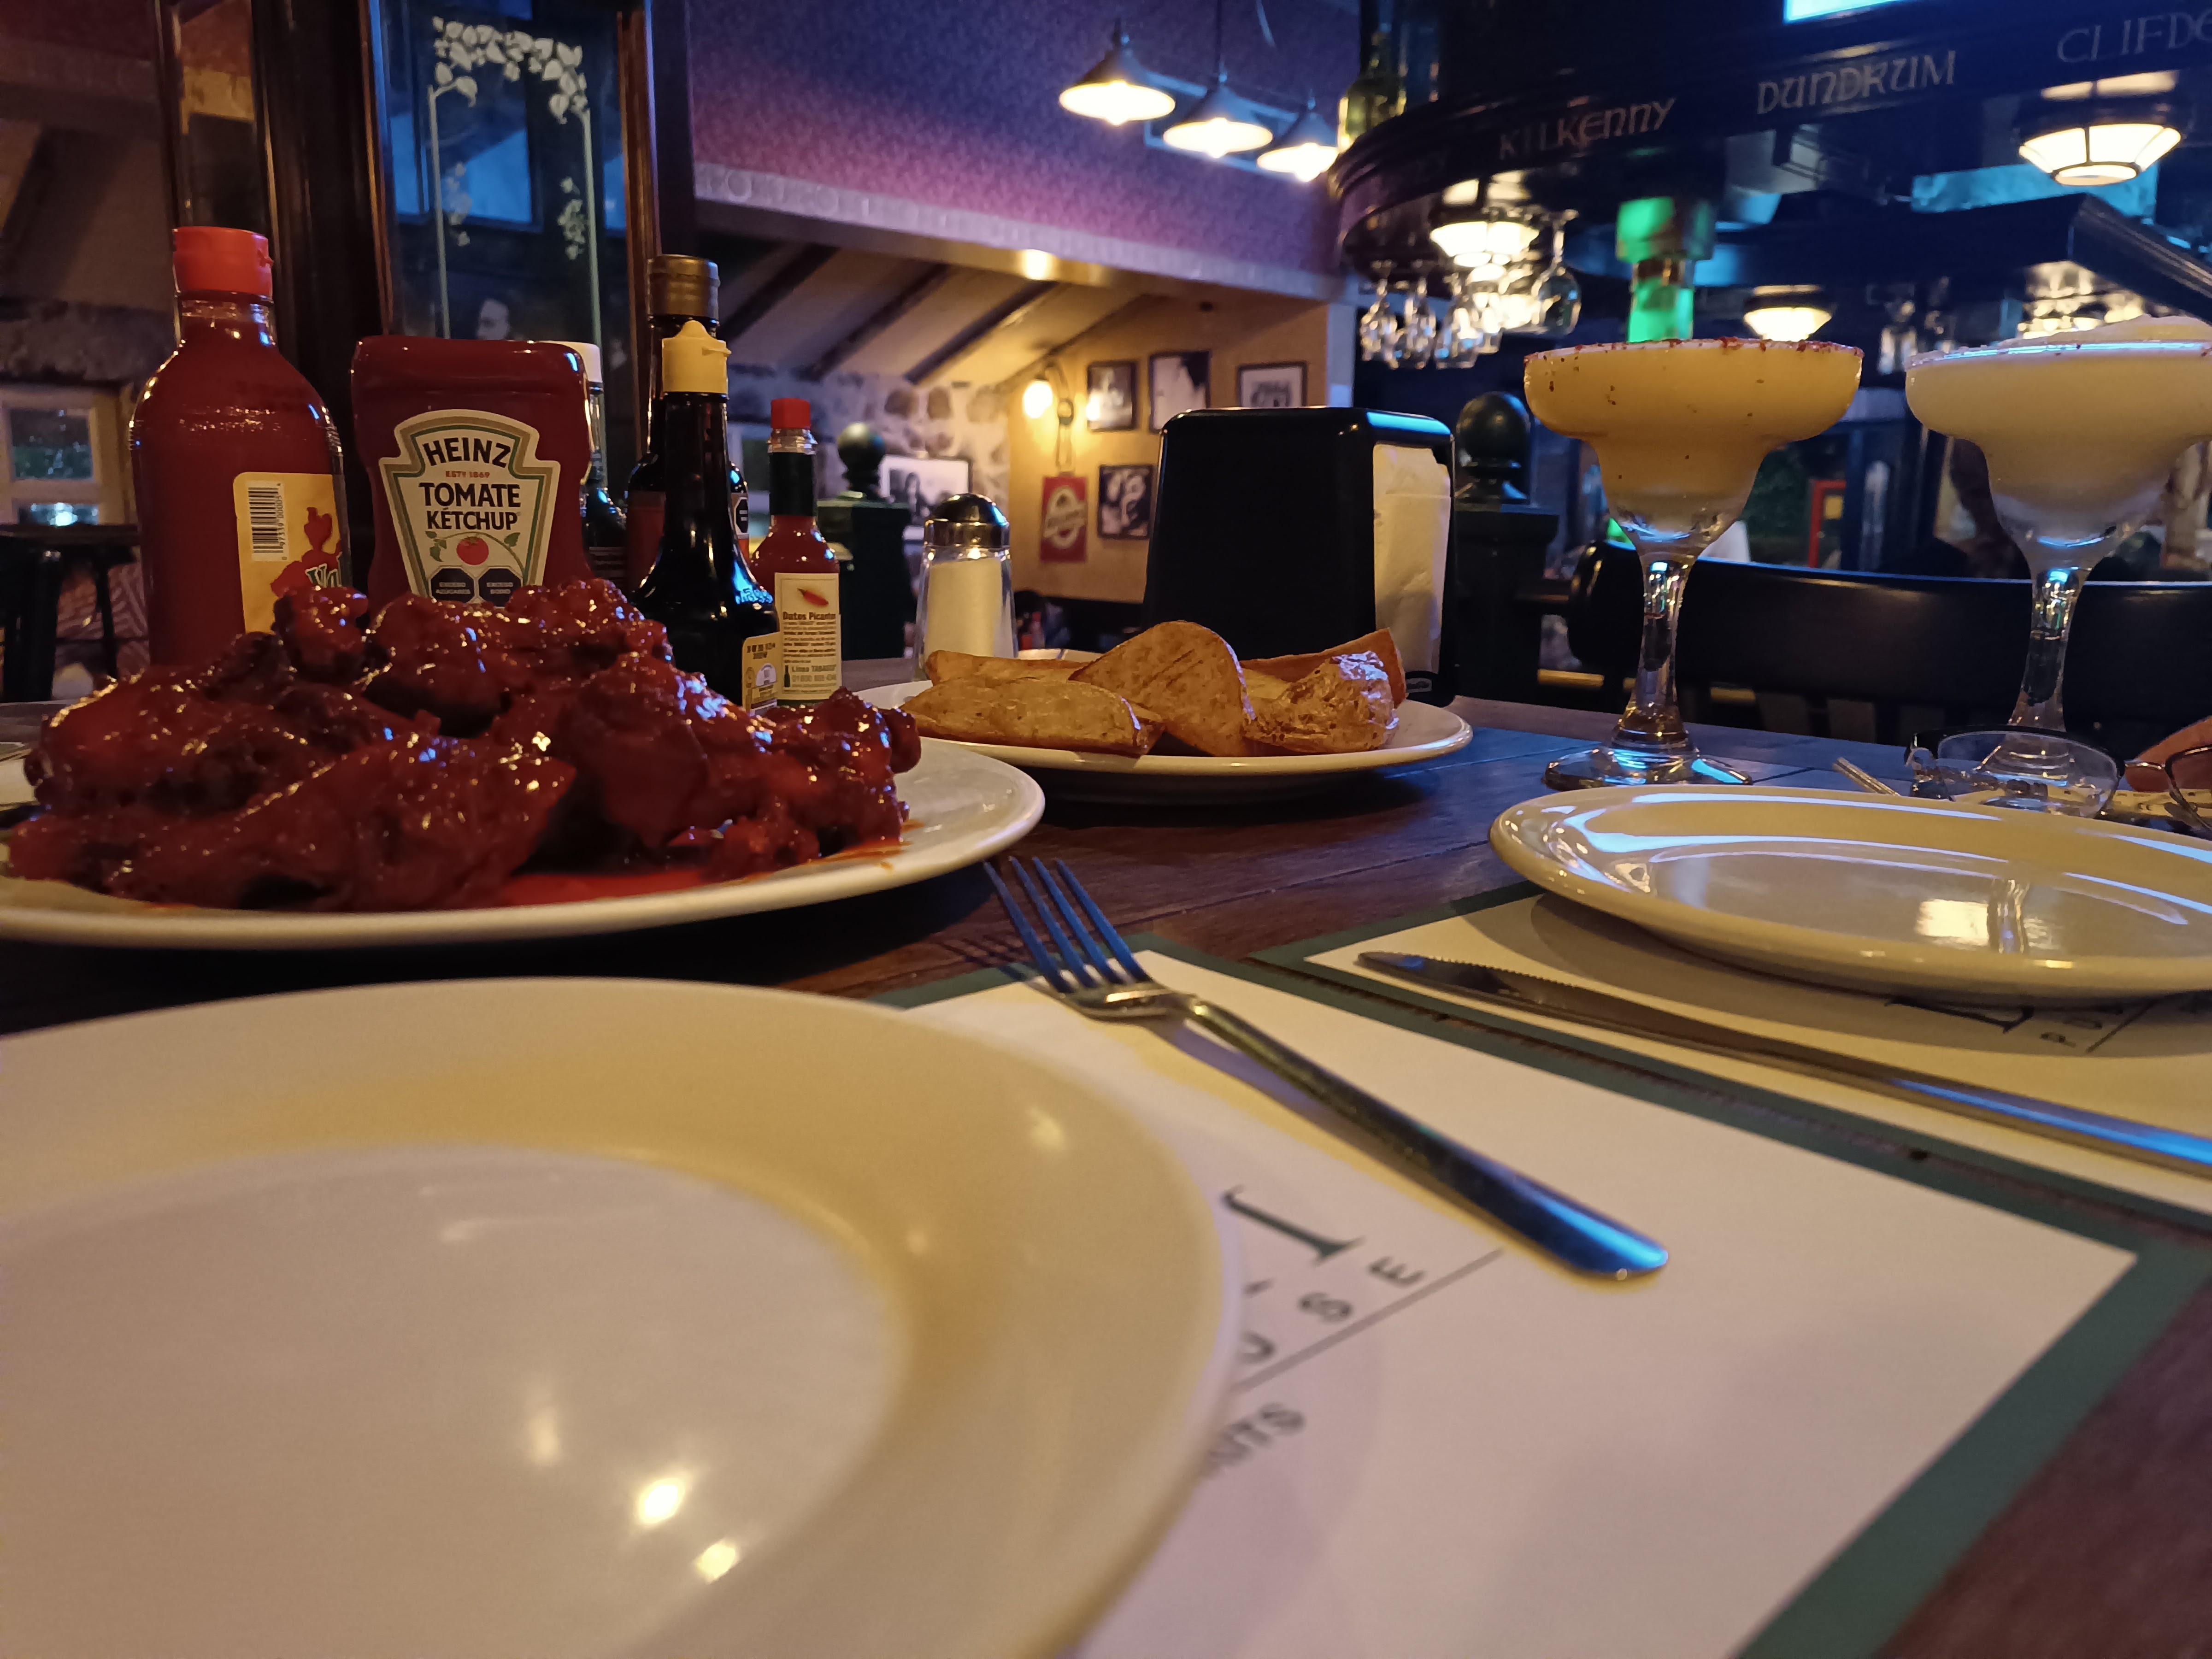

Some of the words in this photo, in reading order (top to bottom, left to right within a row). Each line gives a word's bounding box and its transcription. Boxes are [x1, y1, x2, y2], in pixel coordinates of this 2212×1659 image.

[1757, 50, 1956, 114] DUNDRUM
[422, 437, 511, 468] HEINZ
[418, 482, 521, 507] TOMATE
[783, 612, 806, 620] Datos
